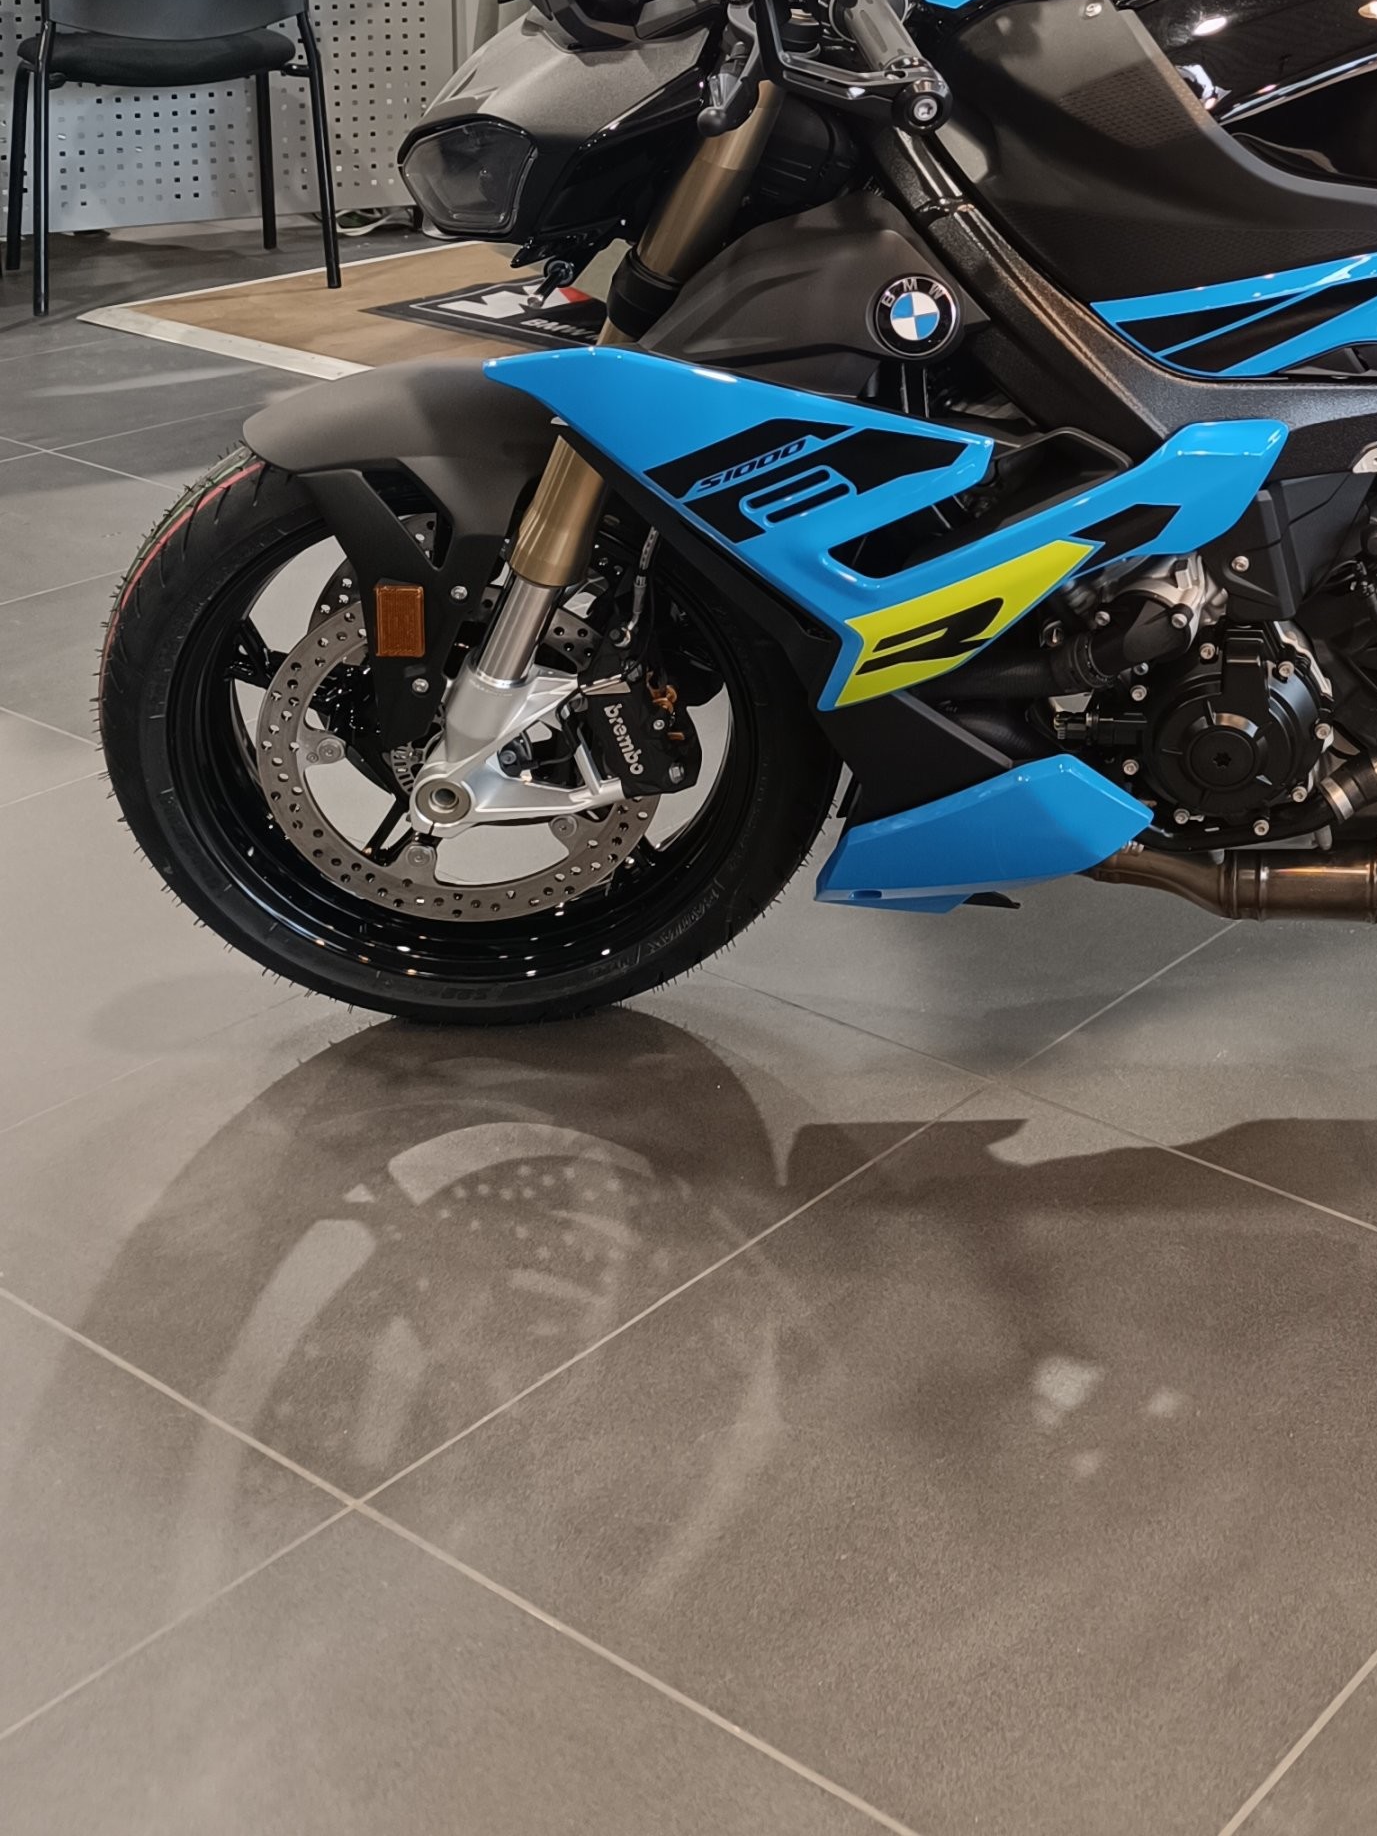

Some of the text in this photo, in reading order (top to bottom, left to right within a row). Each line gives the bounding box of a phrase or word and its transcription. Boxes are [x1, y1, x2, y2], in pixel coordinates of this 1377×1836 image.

[880, 277, 946, 308] BMW
[696, 437, 807, 494] S1000
[603, 703, 645, 775] brembo
